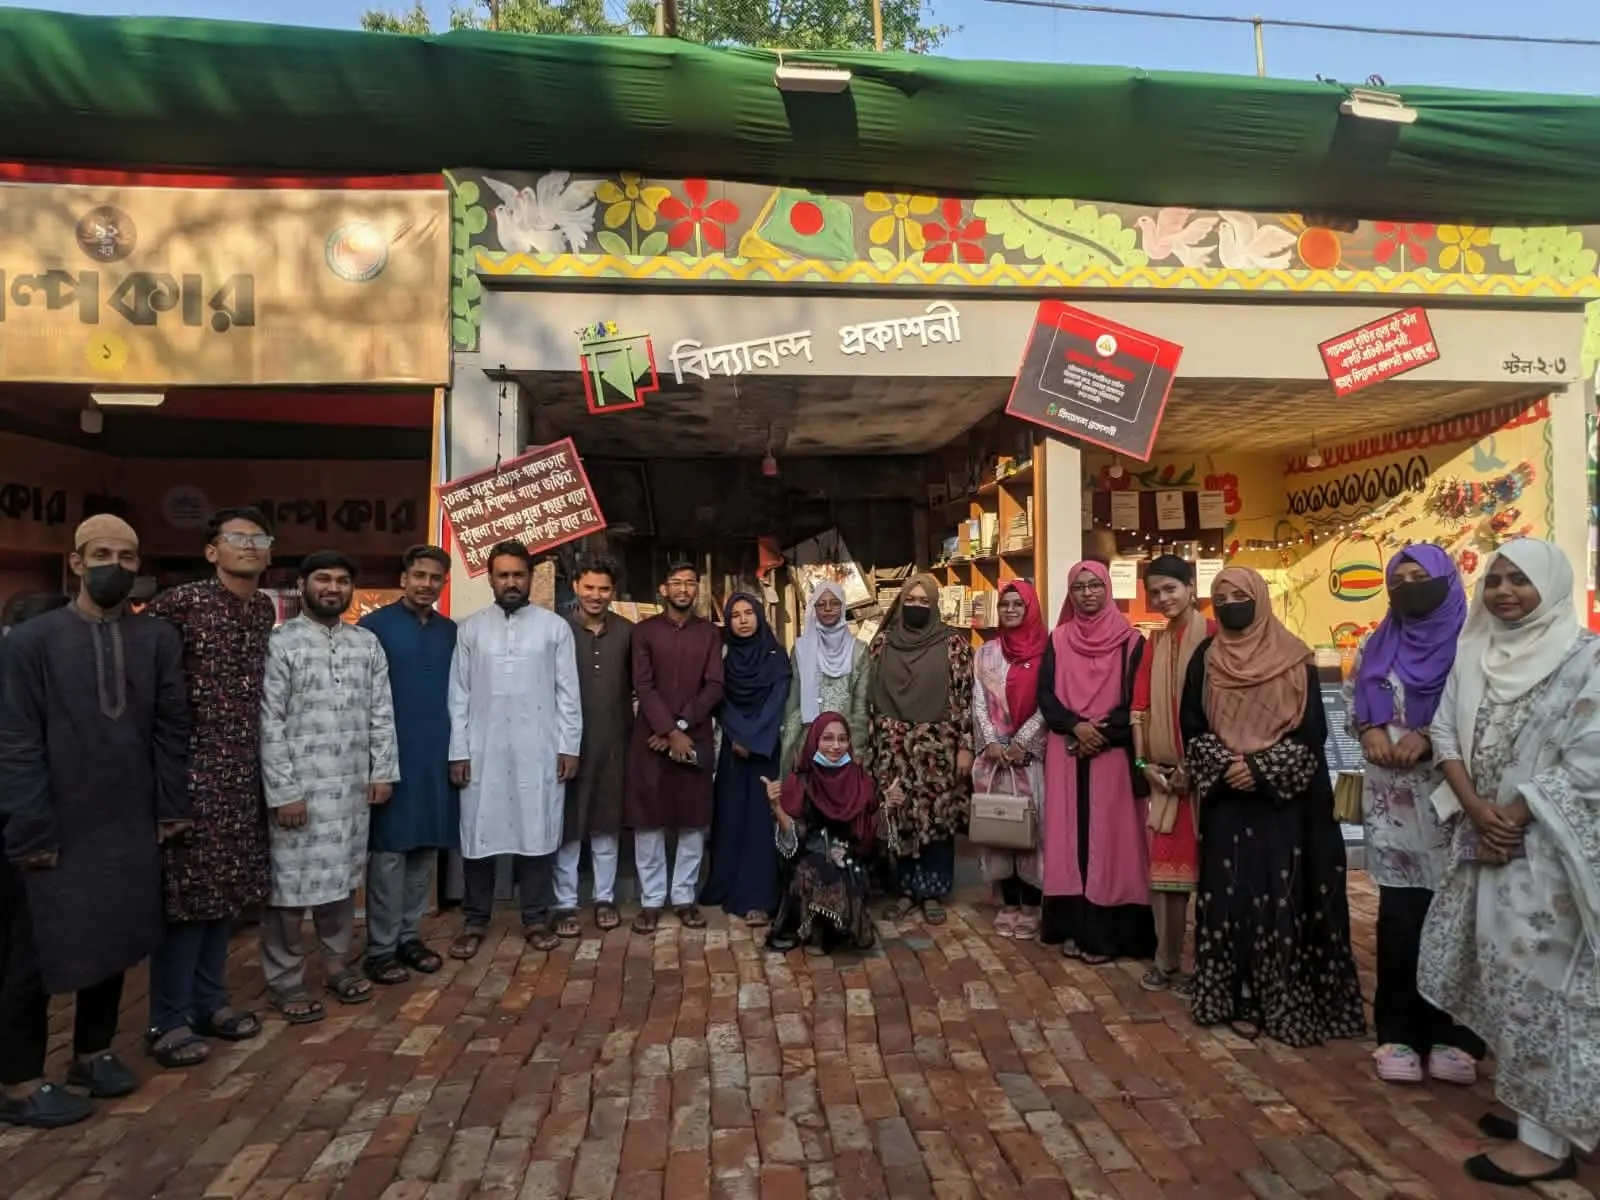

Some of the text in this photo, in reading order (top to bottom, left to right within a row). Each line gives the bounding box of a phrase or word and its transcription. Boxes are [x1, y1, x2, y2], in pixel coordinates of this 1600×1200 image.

[0, 269, 255, 334] ল্পকার
[669, 300, 962, 384] বিদ্যানন্দ প্রকাশনী
[450, 499, 485, 523] প্রকাশনী
[486, 491, 517, 512] শিল্পের
[518, 483, 541, 498] সাথে
[471, 478, 495, 497] মানুষ
[459, 523, 490, 545] বইমেলা
